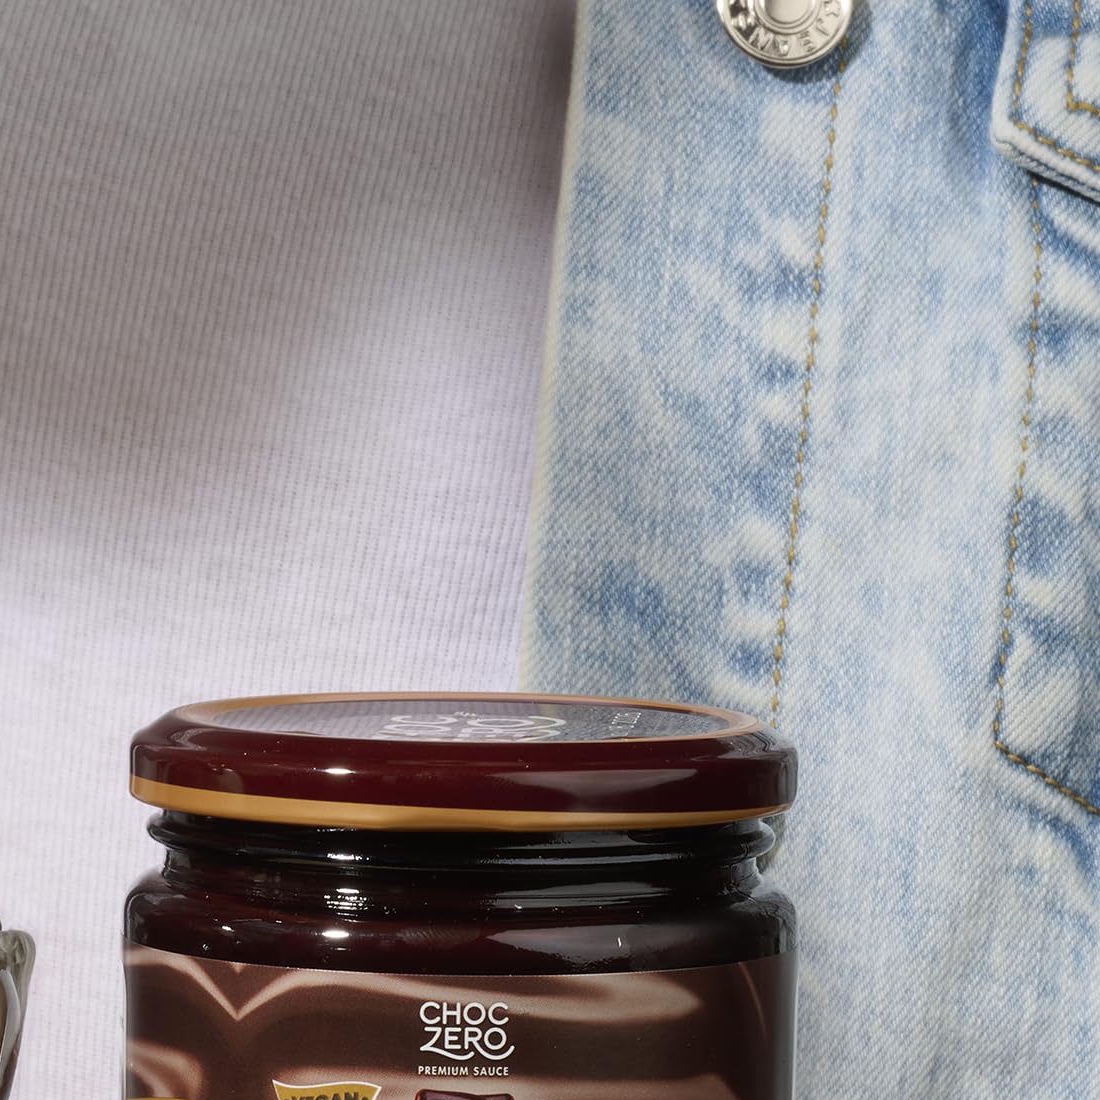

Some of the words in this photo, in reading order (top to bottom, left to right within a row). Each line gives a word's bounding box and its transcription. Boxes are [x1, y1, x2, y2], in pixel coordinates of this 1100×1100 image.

[419, 1001, 510, 1025] CHOC
[419, 1027, 516, 1061] ZERO
[418, 1065, 469, 1076] PREMIUM
[473, 1066, 509, 1076] SAUCE
